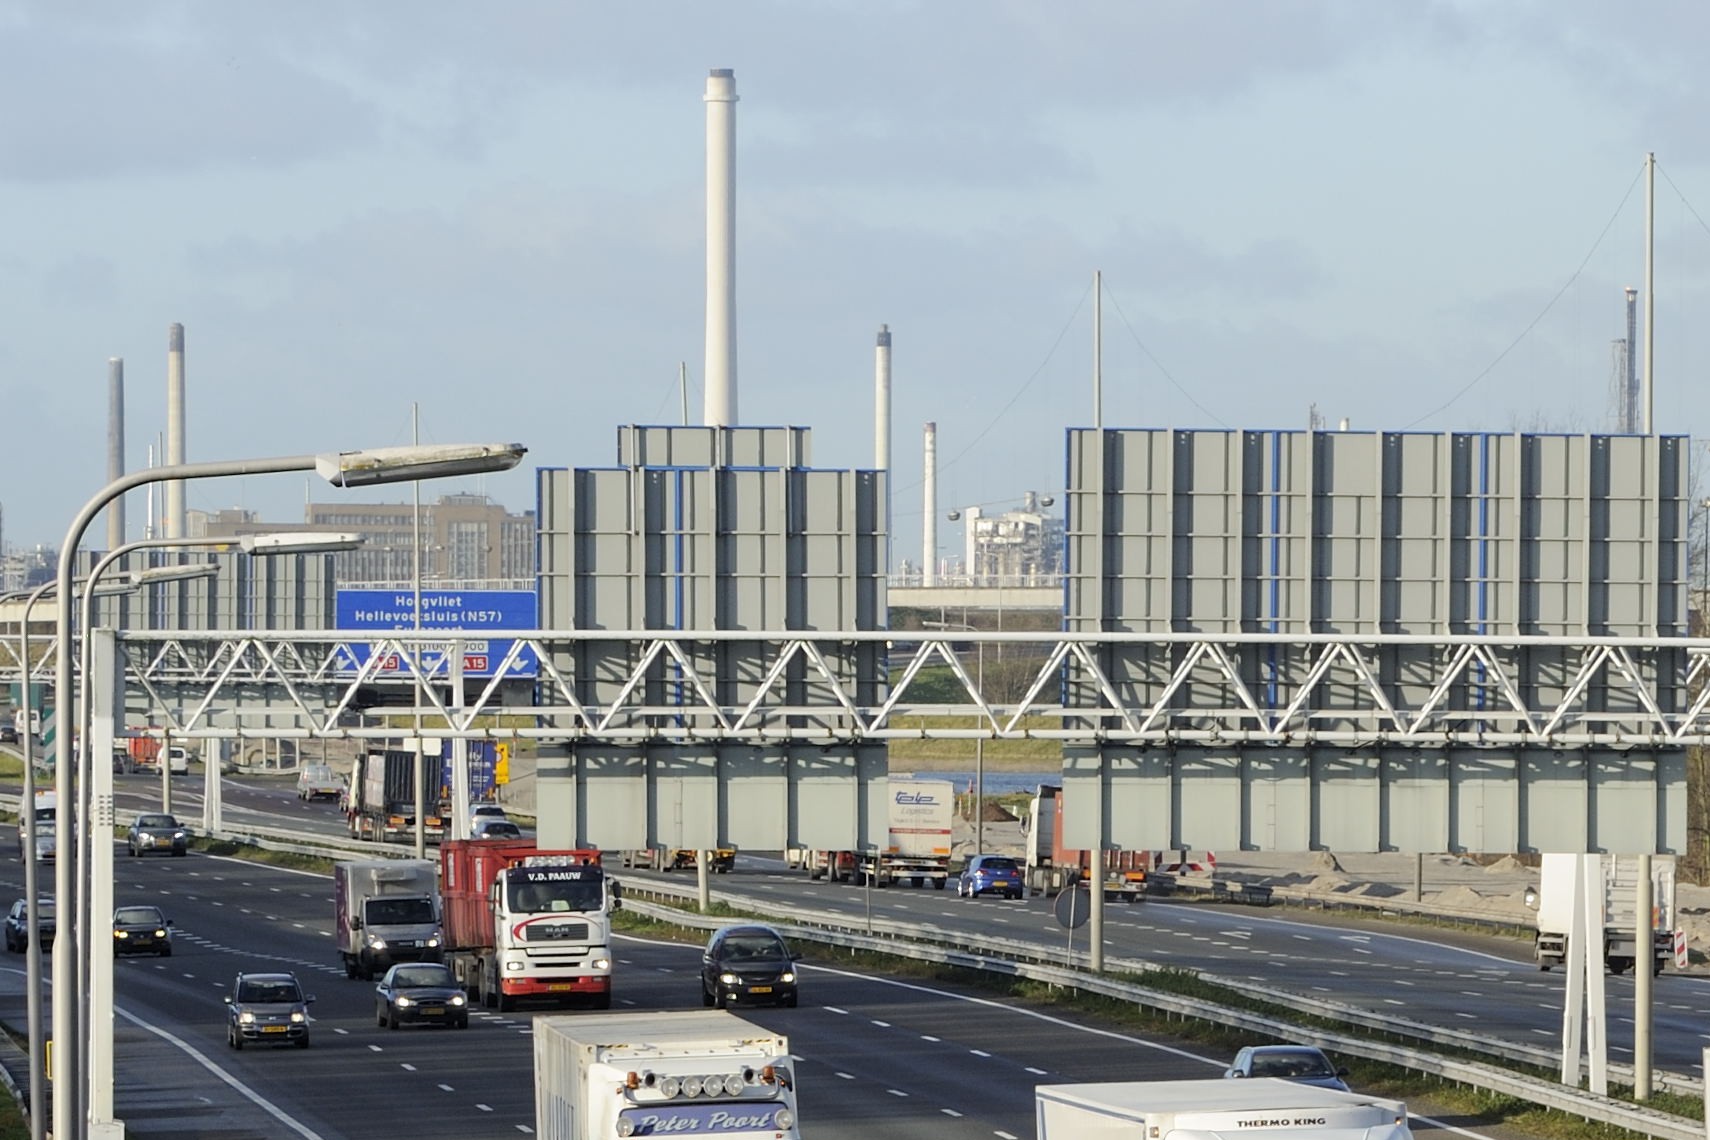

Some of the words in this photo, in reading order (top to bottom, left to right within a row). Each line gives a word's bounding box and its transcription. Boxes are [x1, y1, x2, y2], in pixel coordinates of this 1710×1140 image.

[395, 596, 462, 609] Hogvliet
[355, 611, 458, 622] Hellevoesluis
[460, 610, 502, 623] (N57)
[527, 873, 547, 881] V.D.
[548, 871, 582, 881] PAAUW
[638, 1114, 701, 1134] Peter
[707, 1111, 775, 1130] Poort
[1237, 1119, 1290, 1128] THERMO
[1294, 1117, 1326, 1126] KING
